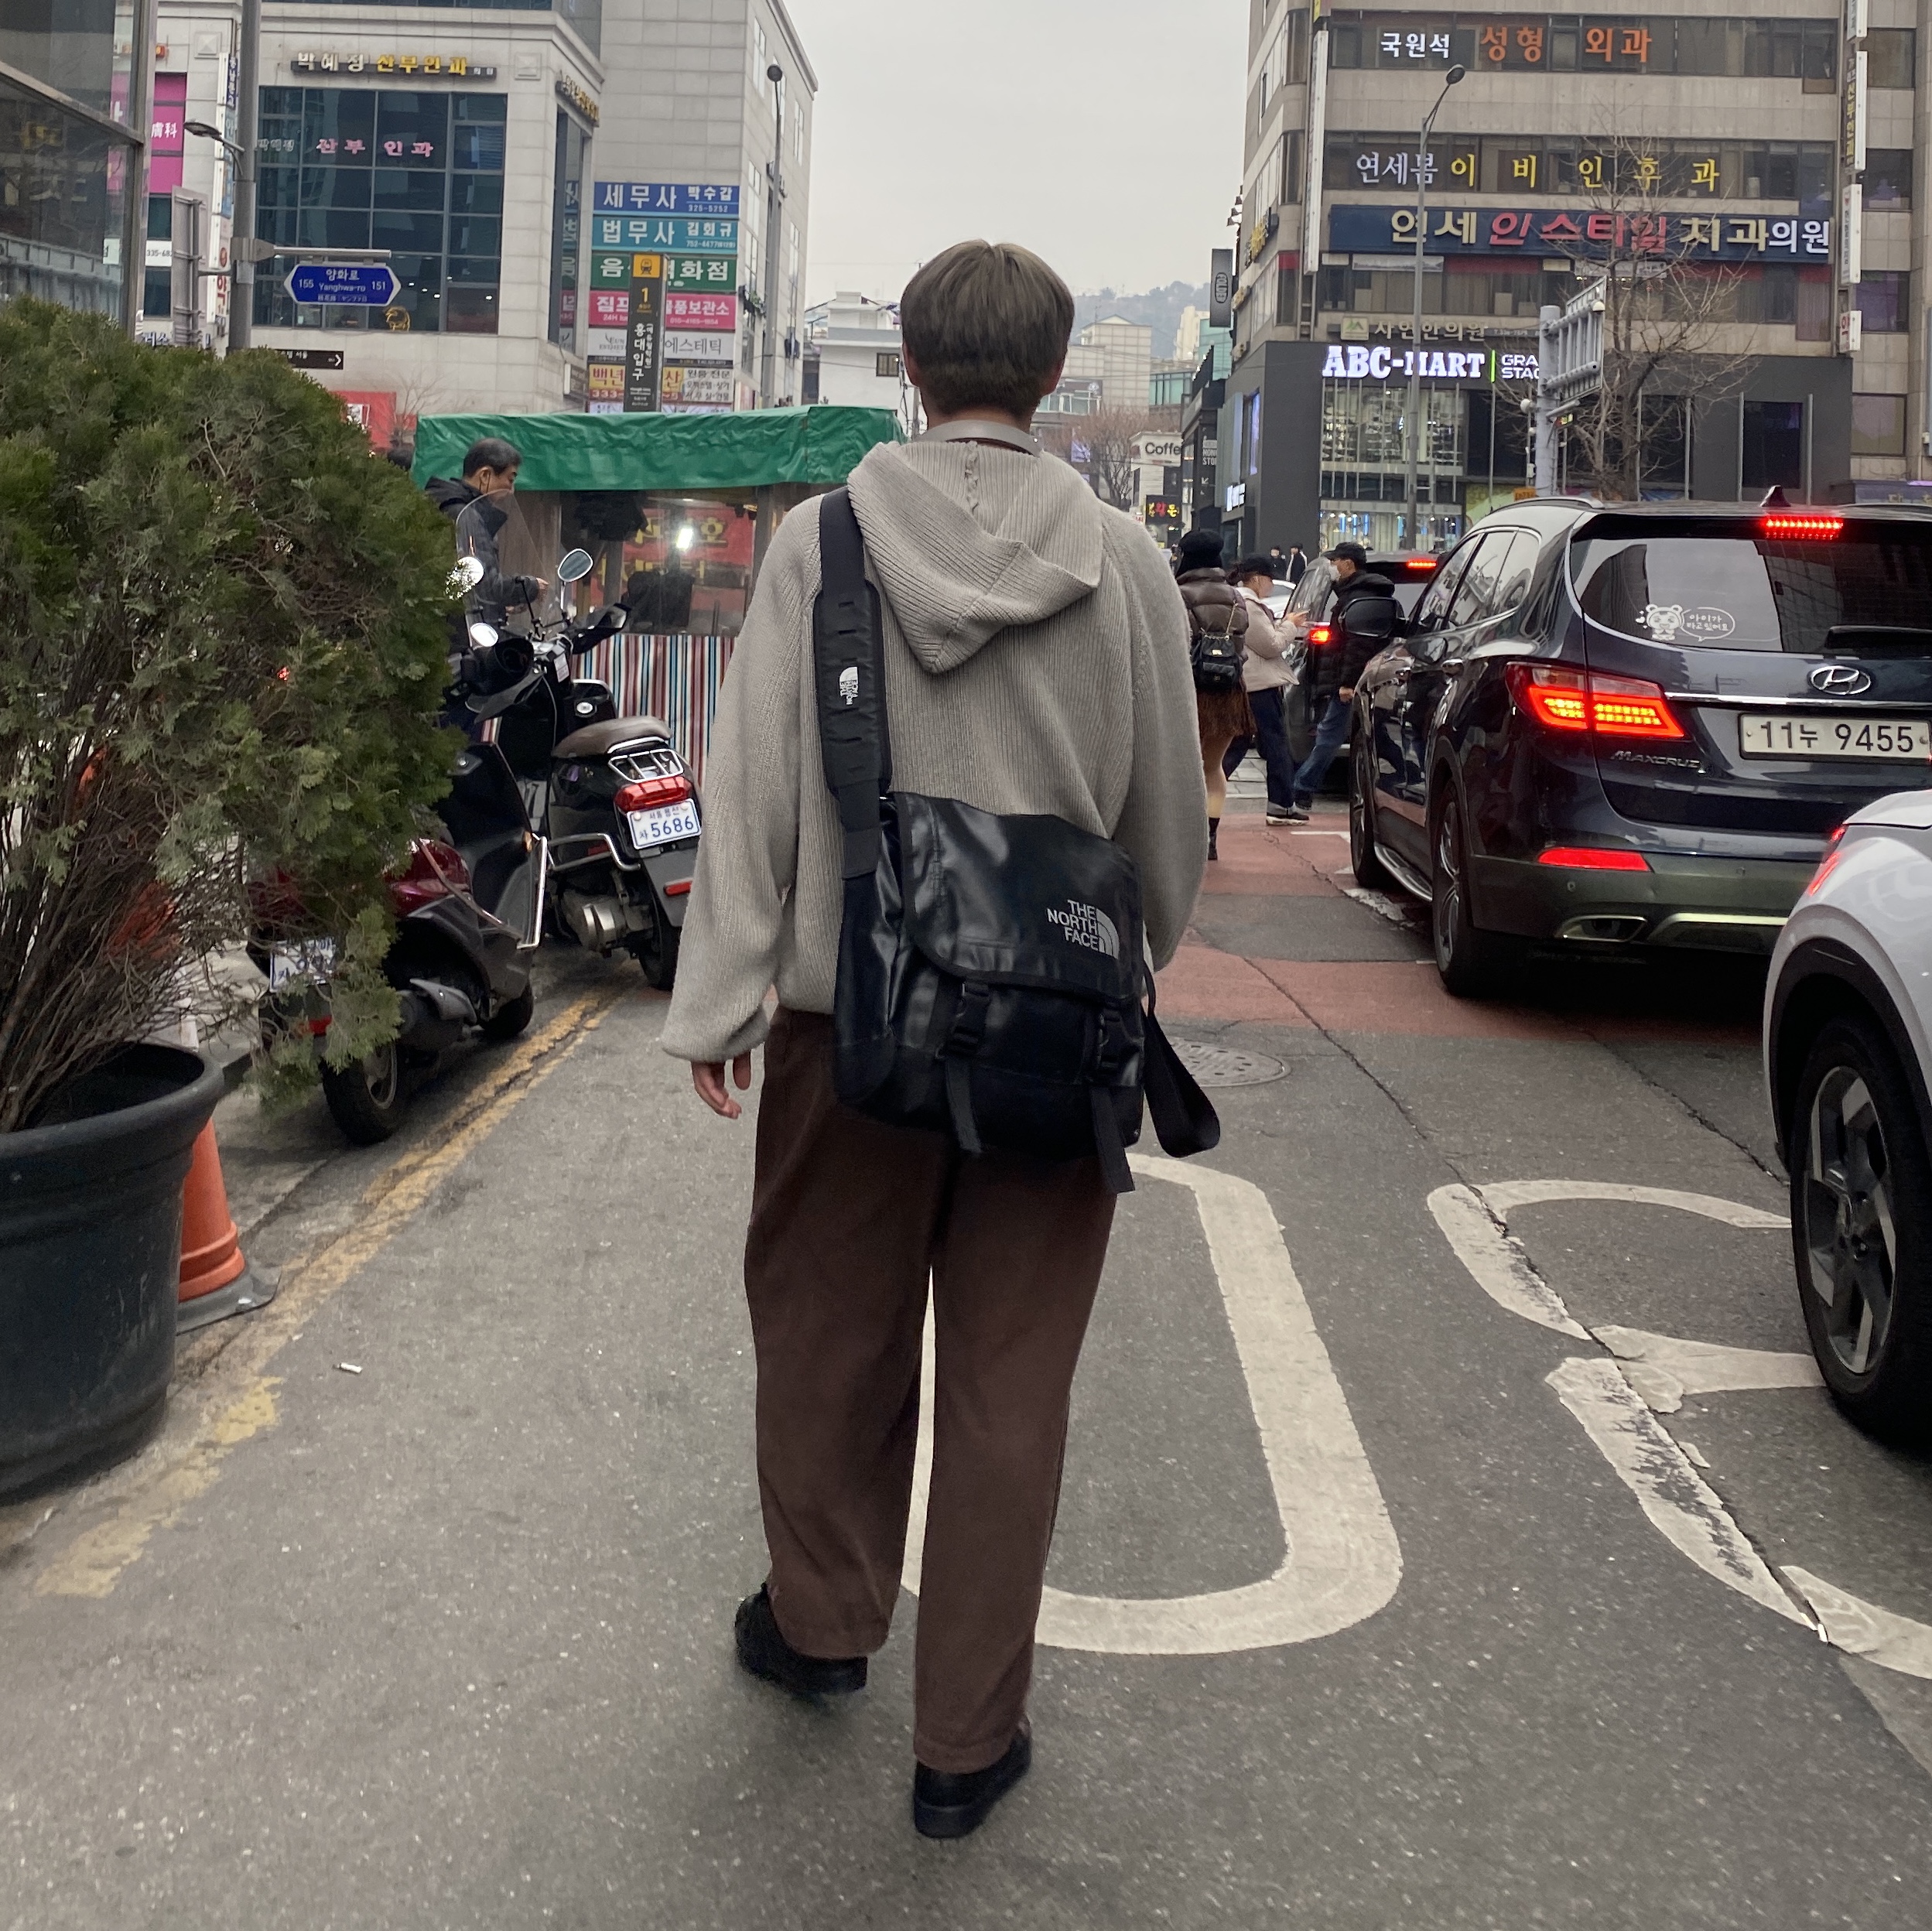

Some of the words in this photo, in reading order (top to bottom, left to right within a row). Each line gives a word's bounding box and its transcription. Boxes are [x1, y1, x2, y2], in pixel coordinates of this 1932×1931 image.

[1381, 32, 1450, 58] 국원석
[1480, 26, 1544, 63] 성형
[1585, 28, 1653, 63] 외과
[376, 54, 467, 76] 산부인과
[604, 184, 677, 210] 세무사
[601, 220, 675, 245] 법무사
[299, 279, 315, 289] 155
[326, 268, 361, 282] 양화로
[371, 281, 386, 290] 151
[318, 282, 366, 292] Yanghwa-ro
[641, 287, 648, 302] 1
[632, 323, 647, 381] 홍대입구
[1322, 345, 1485, 378] ABC-MART
[1501, 354, 1539, 367] GRA
[1501, 367, 1540, 379] STA
[1145, 442, 1181, 455] Coffe
[1689, 613, 1722, 623] 아이가
[1760, 721, 1818, 749] 11누
[1835, 723, 1914, 753] 9455
[651, 815, 694, 838] 5686
[1046, 907, 1099, 935] NORTH
[1068, 899, 1096, 921] THE
[1064, 927, 1099, 951] FACE
